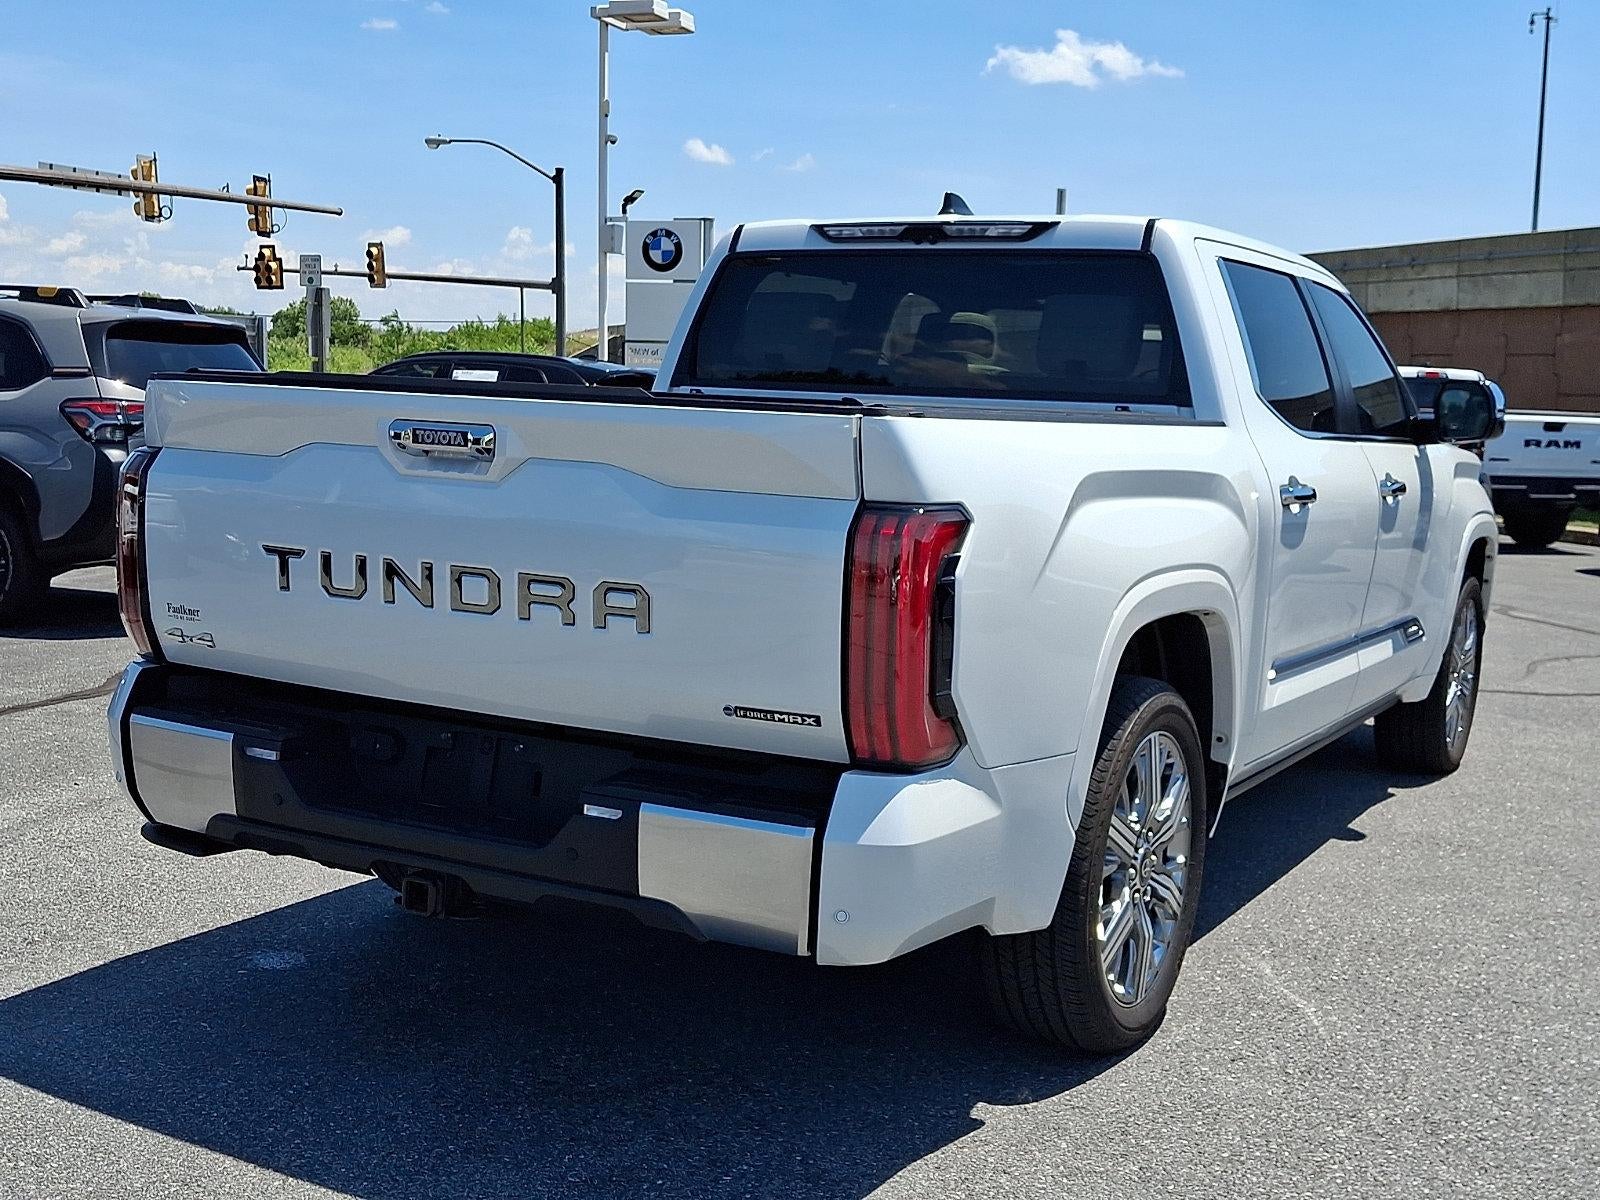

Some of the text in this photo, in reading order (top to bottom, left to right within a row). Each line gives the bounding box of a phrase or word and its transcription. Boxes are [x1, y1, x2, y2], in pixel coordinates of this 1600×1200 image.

[415, 429, 465, 445] TOYOTA
[1523, 439, 1582, 449] RAM
[261, 543, 652, 635] TUNDRA
[166, 602, 201, 618] Faulkner
